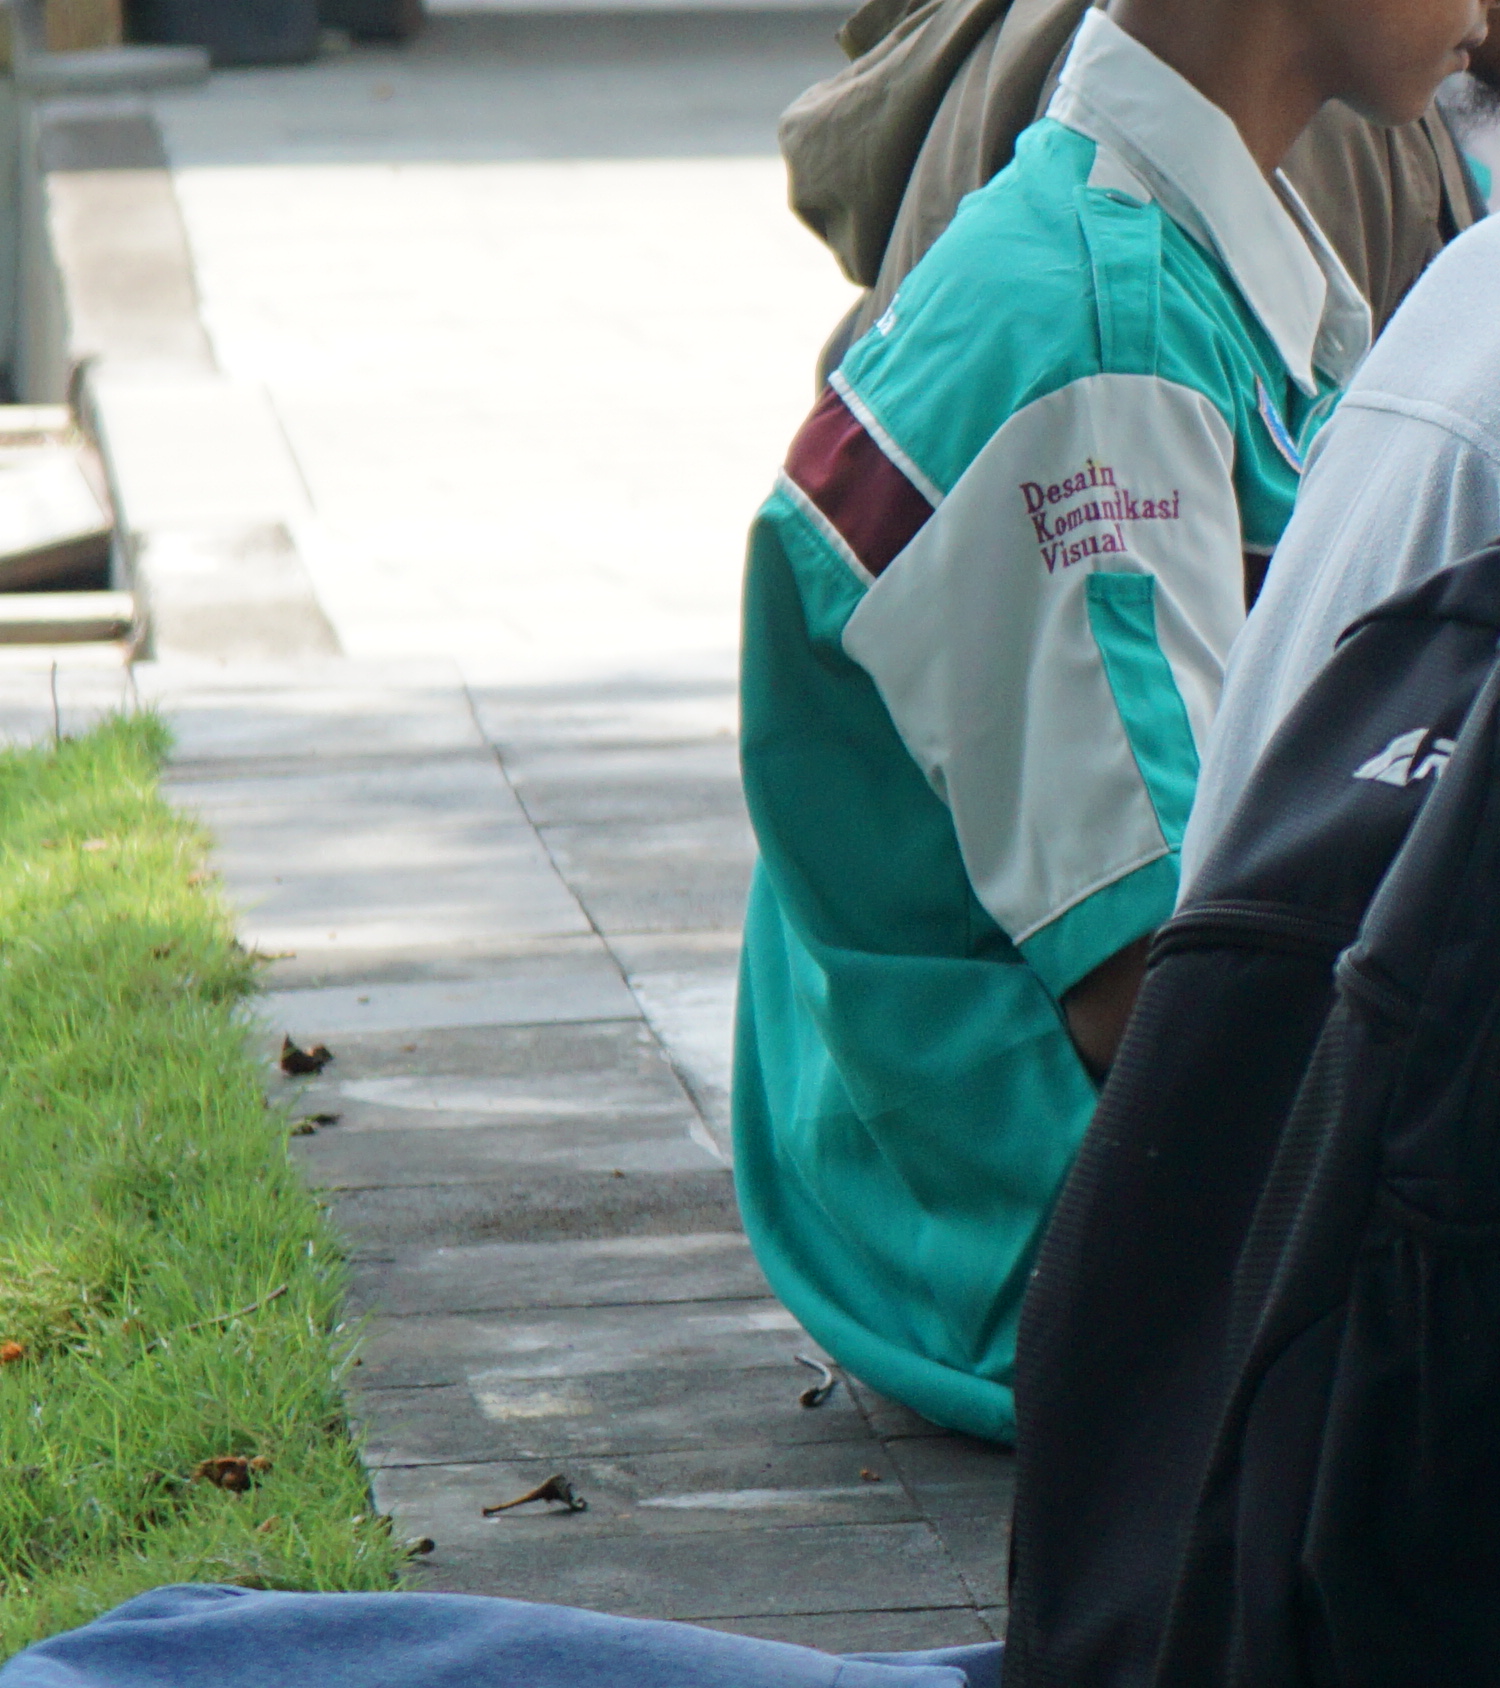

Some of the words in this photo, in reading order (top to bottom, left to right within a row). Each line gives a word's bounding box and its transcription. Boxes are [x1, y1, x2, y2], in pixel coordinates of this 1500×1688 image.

[1020, 457, 1116, 514] Desain
[1031, 489, 1179, 543] Komunikasi
[1041, 523, 1127, 573] Visual
